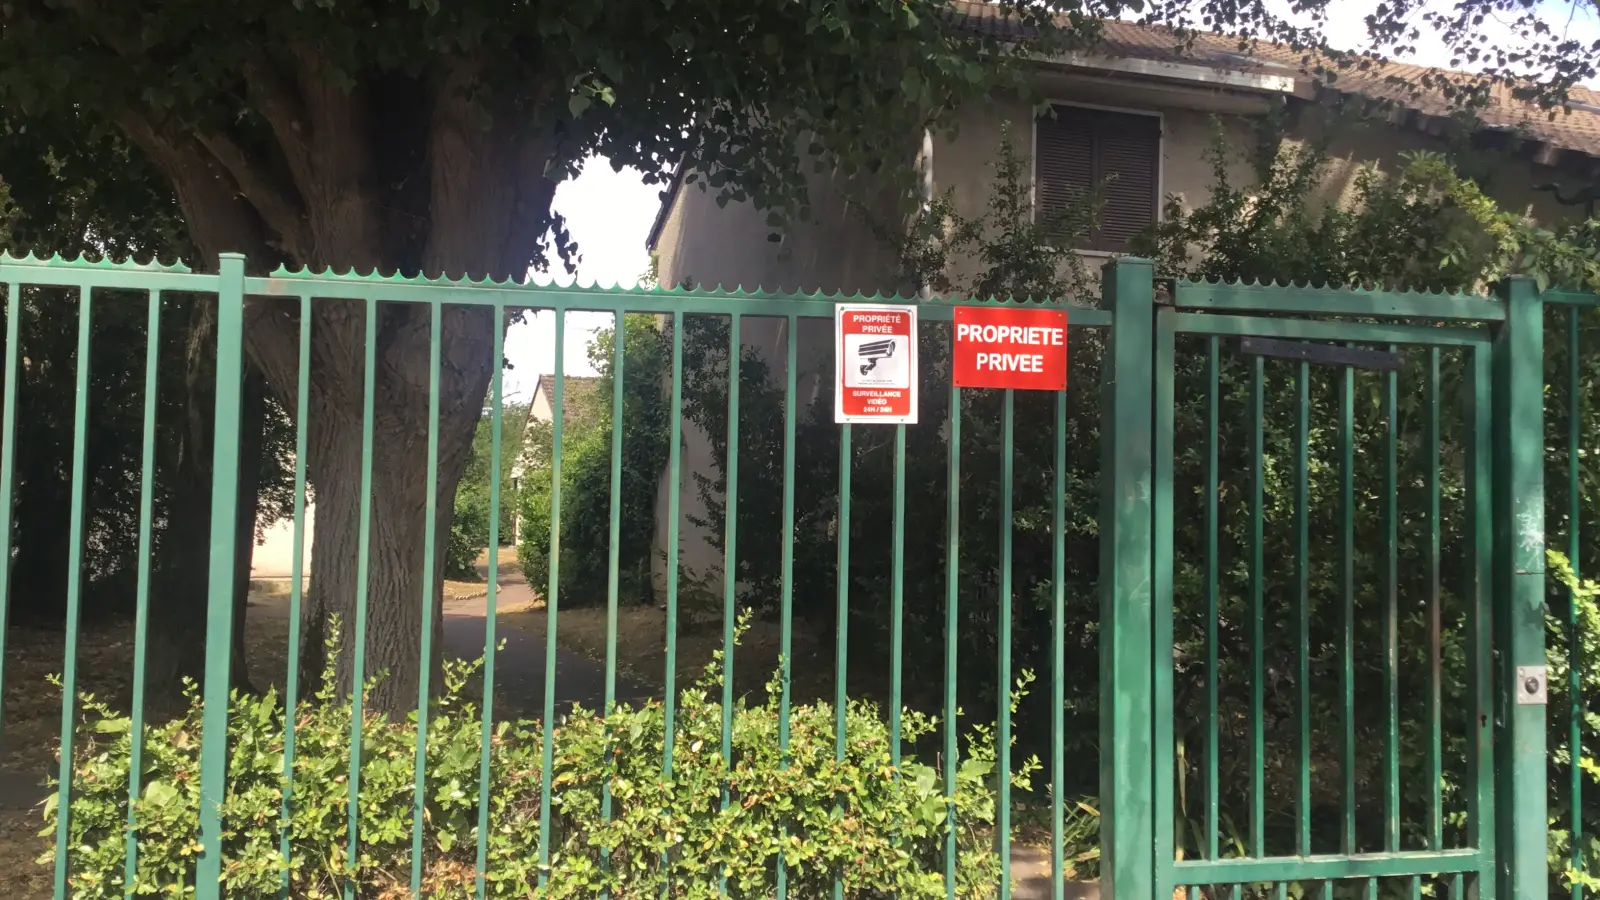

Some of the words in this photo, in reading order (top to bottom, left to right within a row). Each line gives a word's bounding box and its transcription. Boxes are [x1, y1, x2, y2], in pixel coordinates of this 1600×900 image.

[852, 314, 902, 324] PROPRIÉTÉ
[862, 324, 893, 334] PRIVÉE
[957, 323, 1064, 345] PROPRIETE
[976, 352, 1044, 373] PRIVEE
[852, 390, 902, 398] SURVEILLANCE
